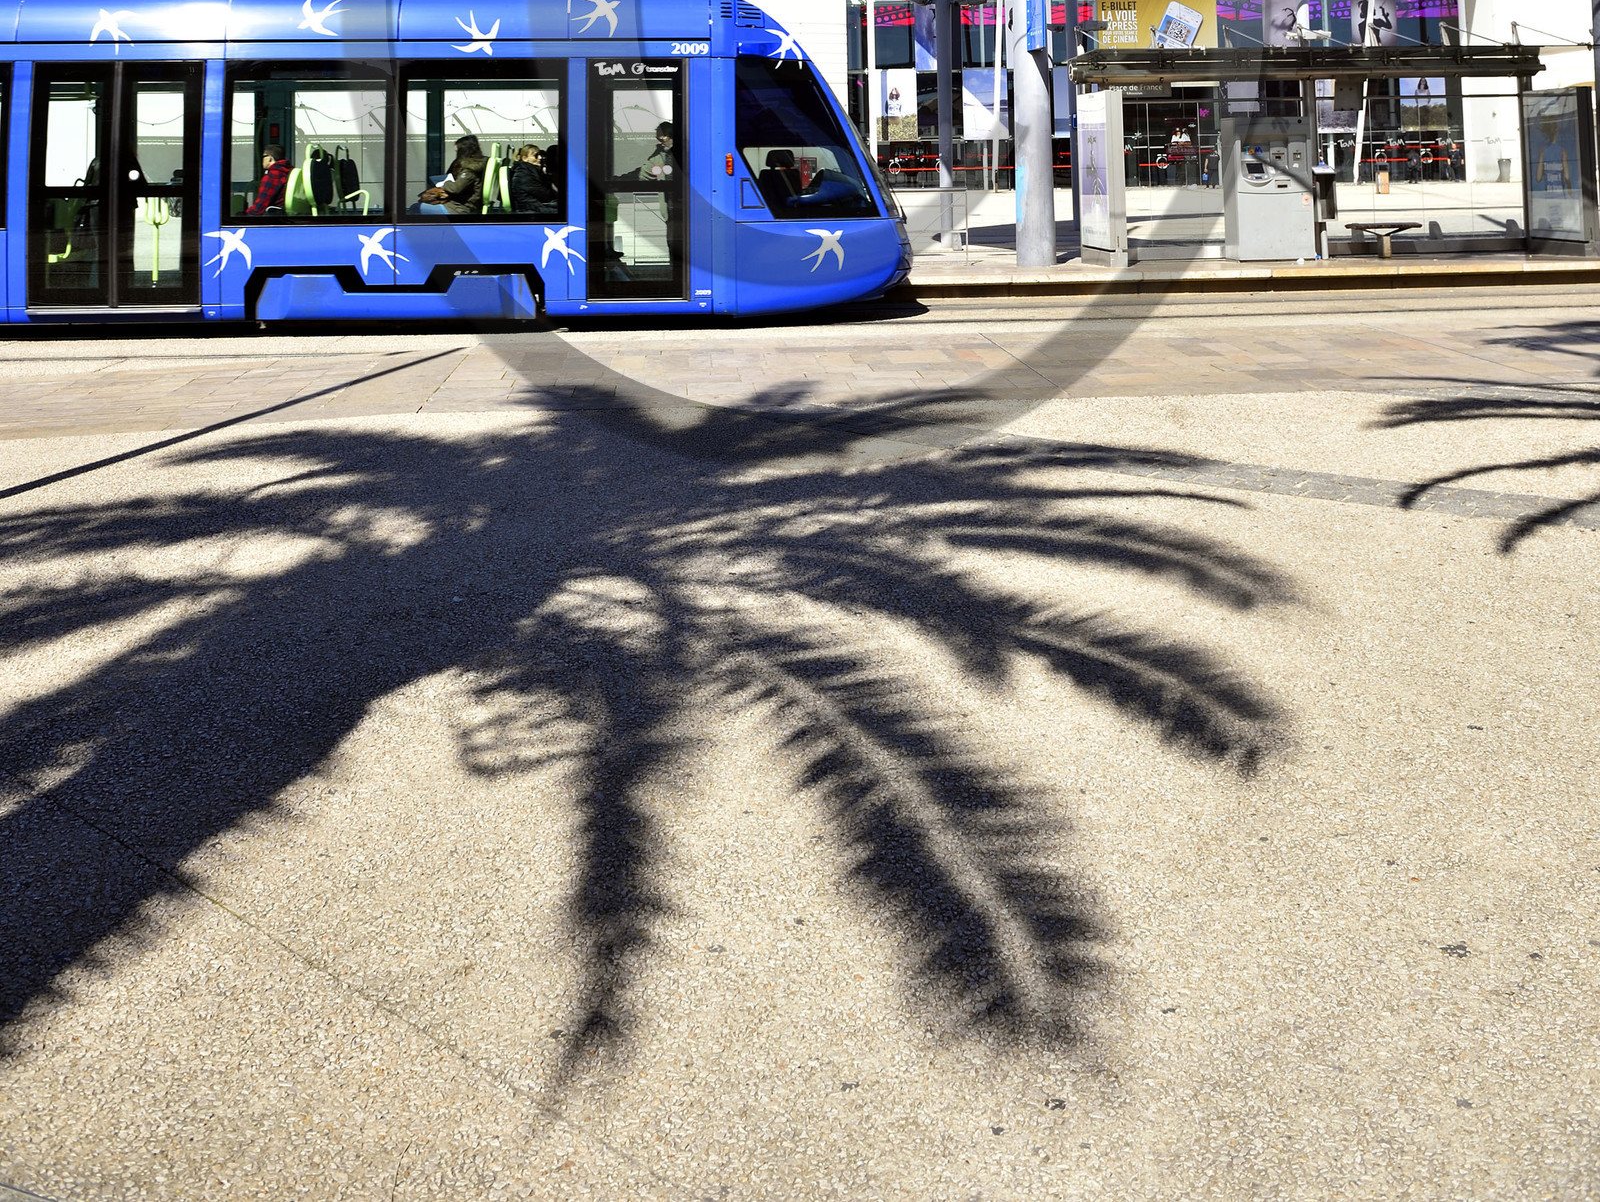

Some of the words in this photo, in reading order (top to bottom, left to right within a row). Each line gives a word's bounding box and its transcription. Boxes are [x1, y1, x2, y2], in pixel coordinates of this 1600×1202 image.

[1101, 1, 1137, 11] E-BILLET
[1101, 10, 1113, 22] LA
[1115, 10, 1138, 22] VOIE
[1105, 21, 1138, 31] XPRESS
[1102, 35, 1112, 44] DE
[671, 42, 709, 55] 2009
